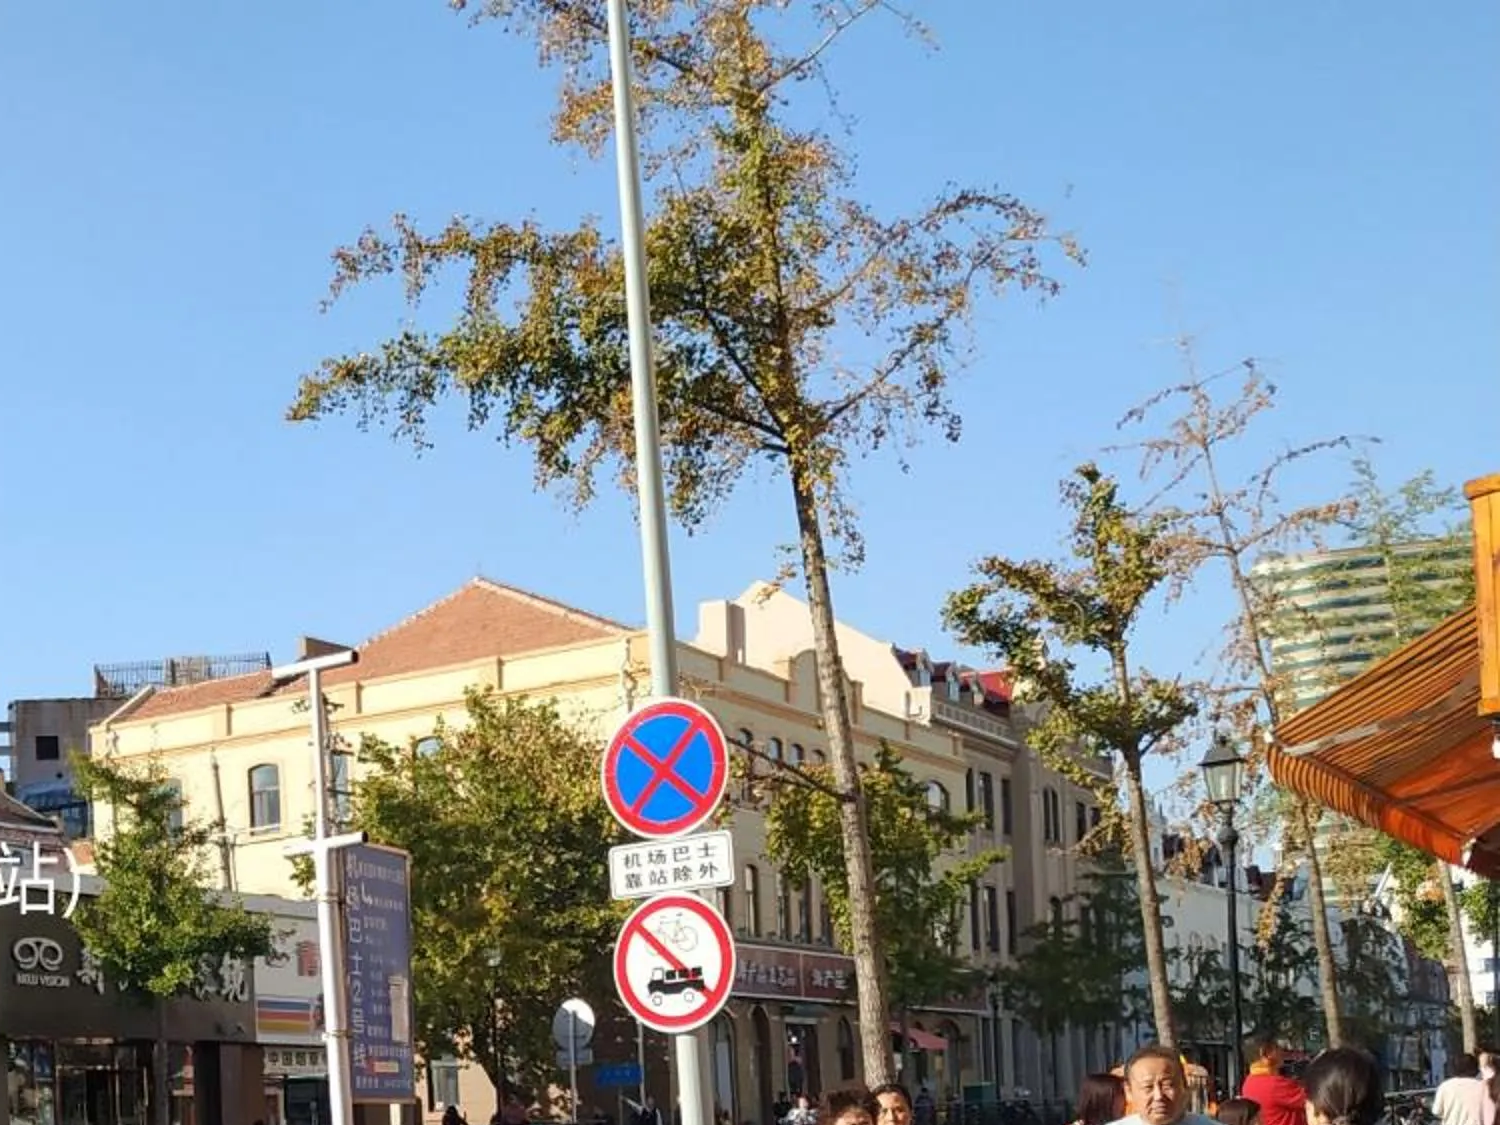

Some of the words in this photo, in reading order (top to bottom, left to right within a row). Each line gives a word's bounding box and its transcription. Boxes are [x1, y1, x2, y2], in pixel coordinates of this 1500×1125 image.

[622, 842, 717, 869] 机场巴士
[624, 861, 719, 890] 靠站除外
